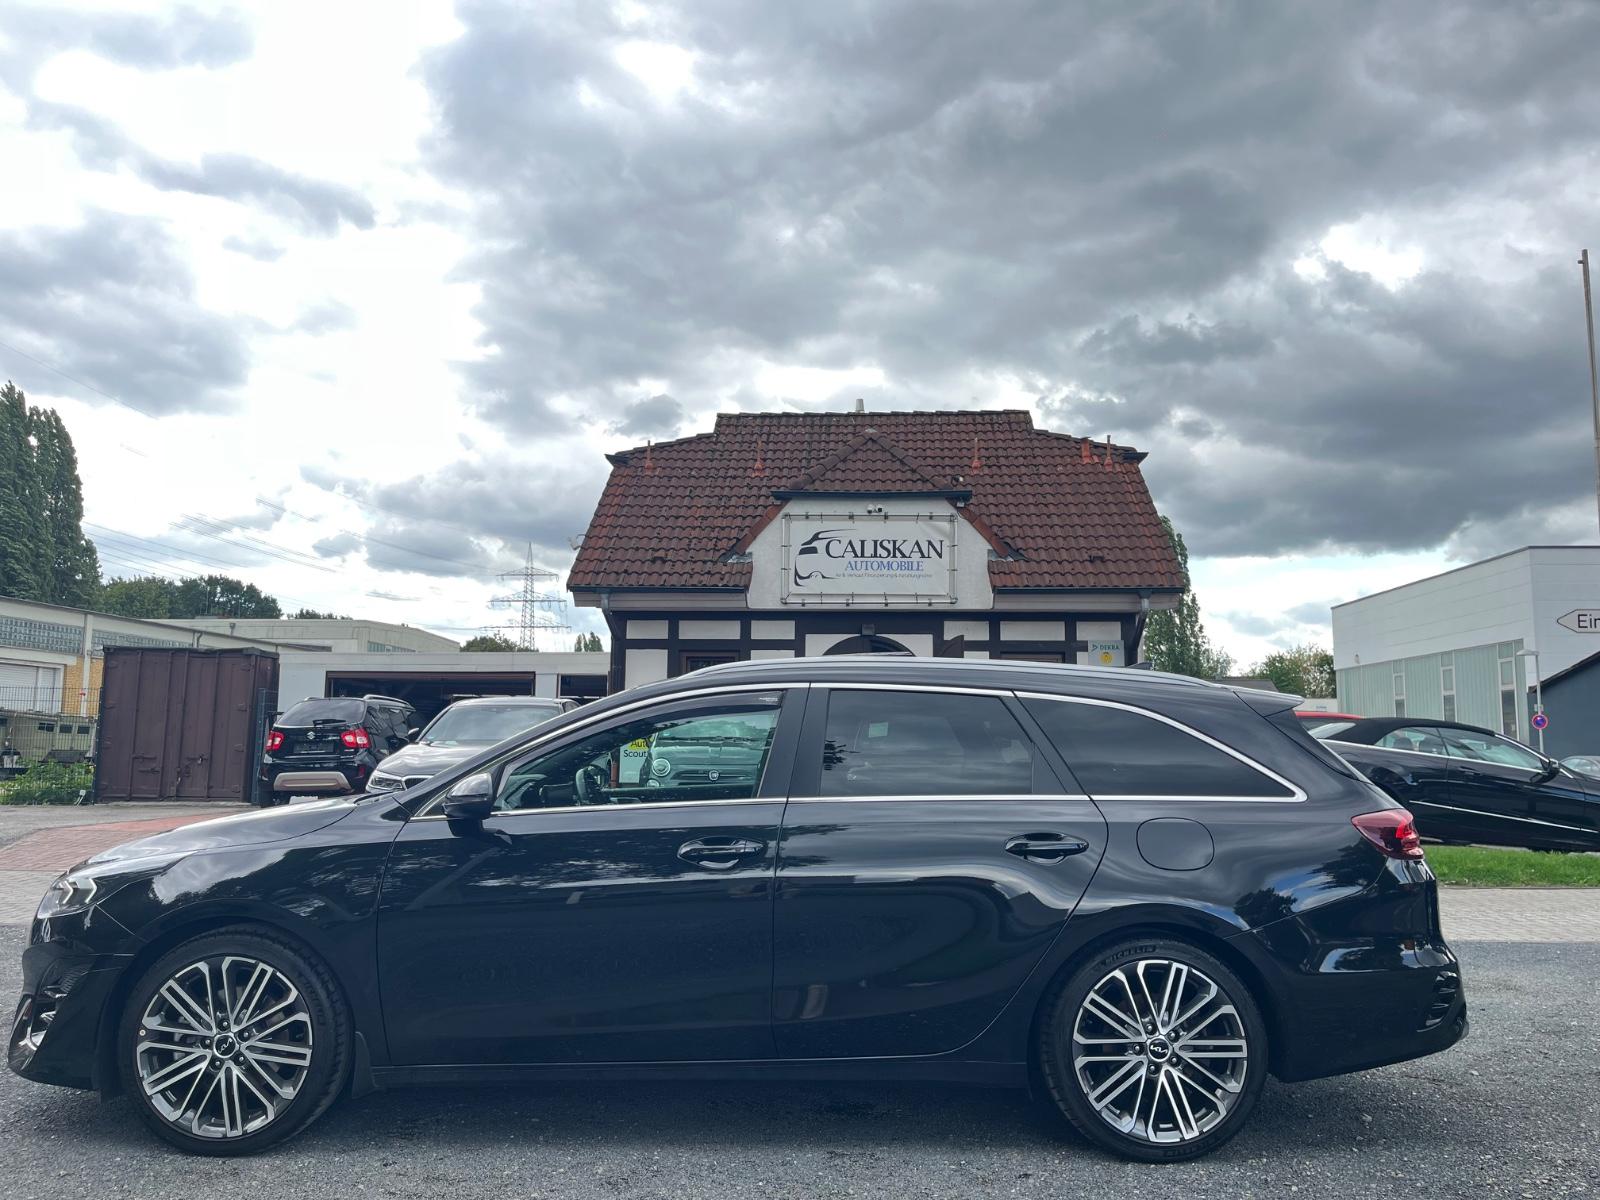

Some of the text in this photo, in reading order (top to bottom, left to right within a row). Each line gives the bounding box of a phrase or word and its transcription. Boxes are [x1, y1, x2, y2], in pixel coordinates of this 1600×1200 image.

[825, 539, 944, 559] CALISKAN
[845, 560, 924, 571] AUTOMOBILE
[630, 740, 648, 748] Aut
[623, 749, 647, 758] Scout
